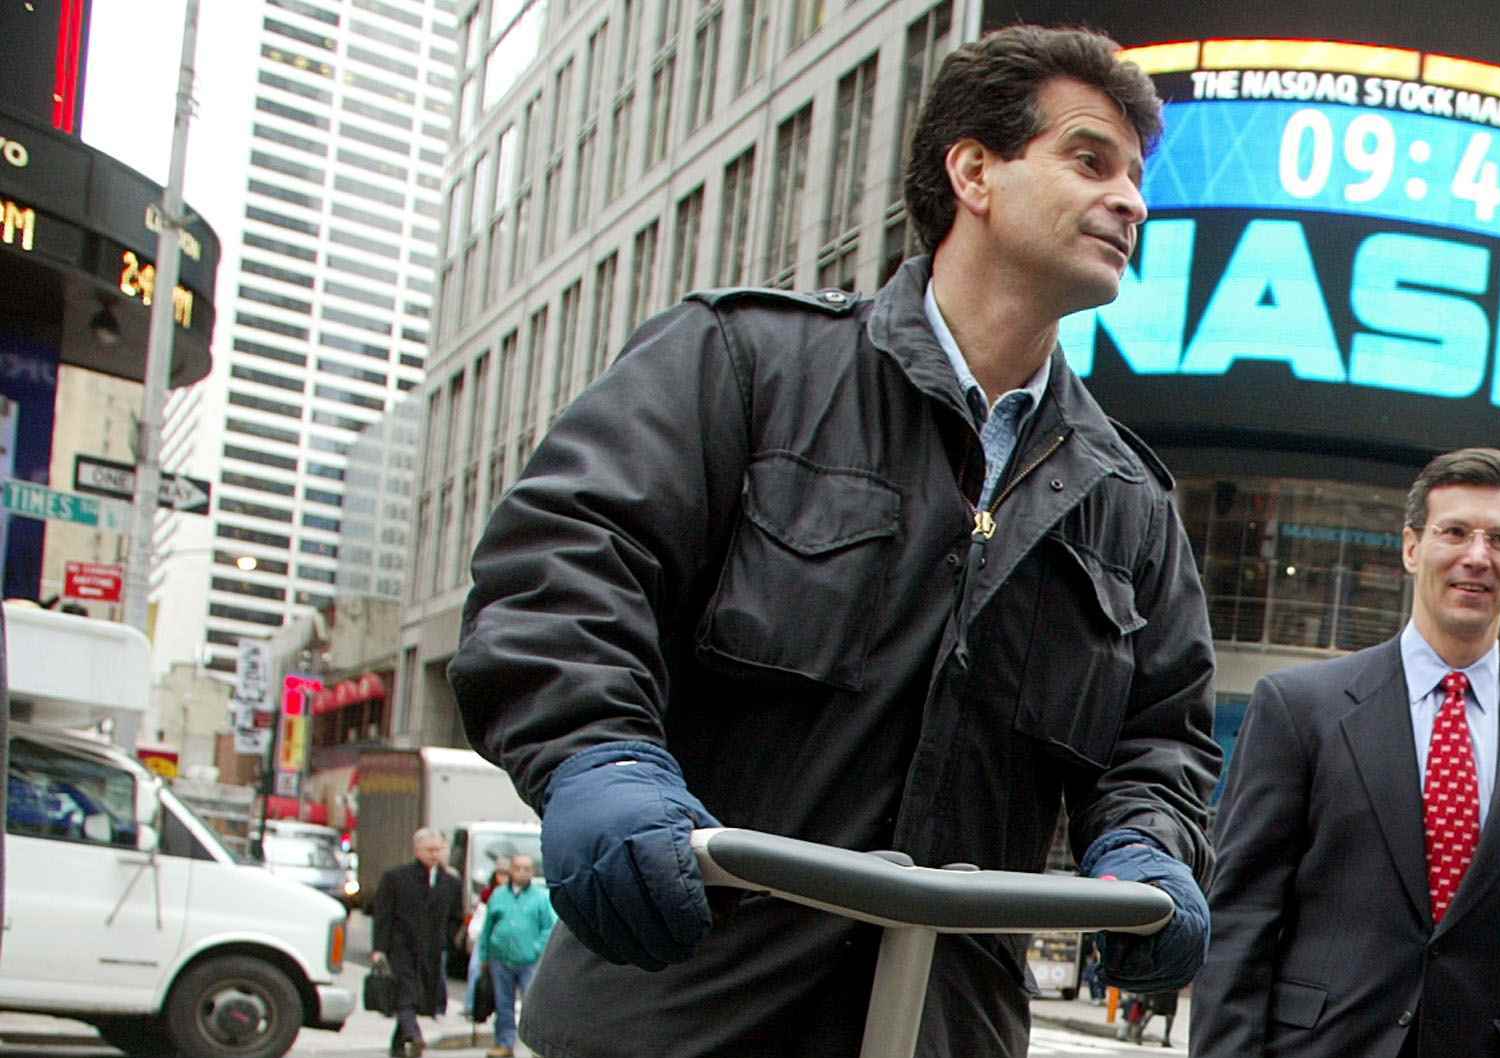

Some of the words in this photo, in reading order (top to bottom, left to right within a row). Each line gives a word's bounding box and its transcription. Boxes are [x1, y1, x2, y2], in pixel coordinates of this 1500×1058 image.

[1191, 71, 1240, 99] THE
[1241, 70, 1359, 104] NASDAQ
[1364, 77, 1454, 116] STOCK
[9, 483, 73, 519] TIMES
